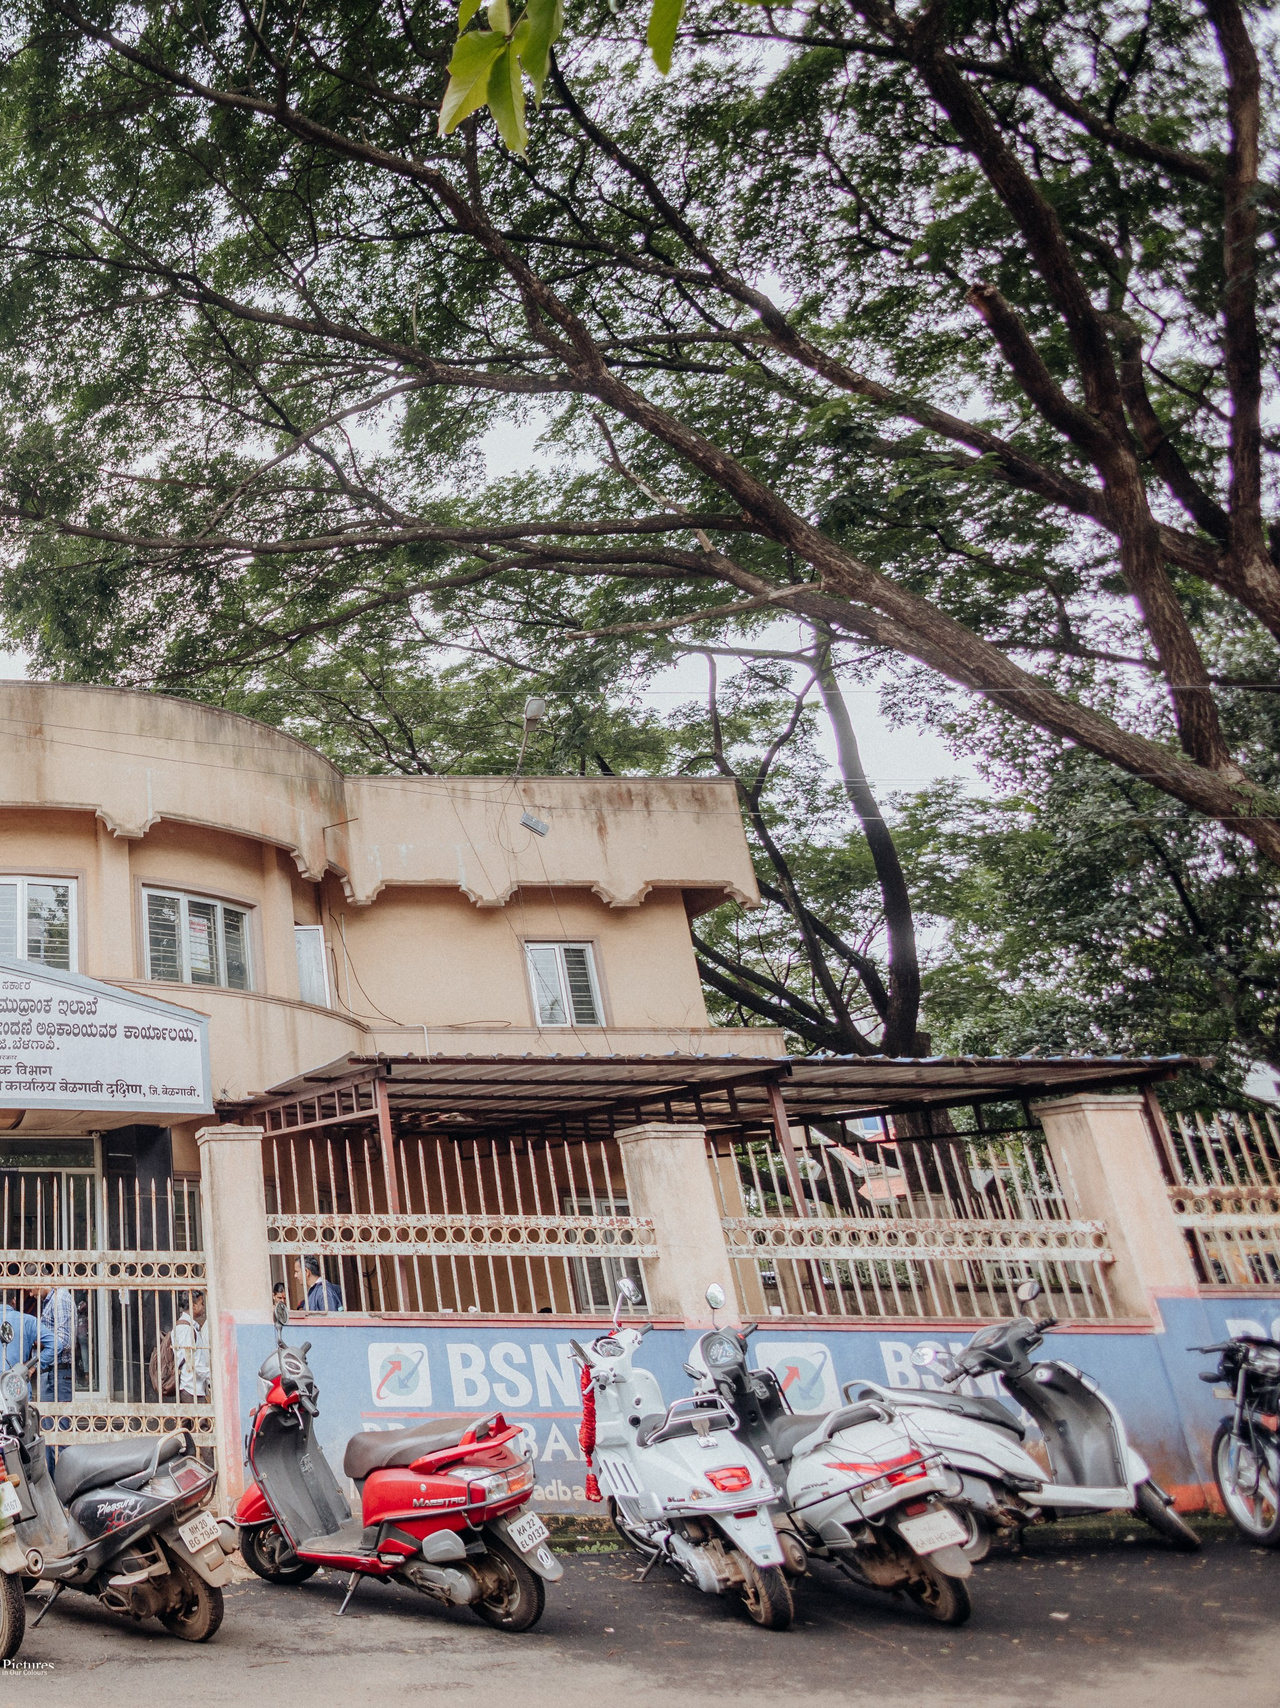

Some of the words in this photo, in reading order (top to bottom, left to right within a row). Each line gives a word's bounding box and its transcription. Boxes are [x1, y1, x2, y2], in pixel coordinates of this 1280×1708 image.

[1, 980, 32, 991] ಸರ್ಕಾರ
[57, 996, 99, 1017] ಇಲಾಖೆ
[36, 1021, 118, 1039] ಅಧಿಕಾರಿಯವರ
[15, 1061, 53, 1077] विभाग
[4, 1078, 57, 1093] कार्यालय
[446, 1341, 588, 1407] BSN
[96, 1498, 136, 1518] Pleasure
[188, 1524, 200, 1536] MH
[199, 1518, 208, 1530] 20
[516, 1525, 528, 1537] KA
[526, 1518, 536, 1529] 22
[188, 1537, 201, 1549] BG
[200, 1525, 219, 1542] 7945
[520, 1539, 530, 1549] EL
[527, 1525, 546, 1544] 9132
